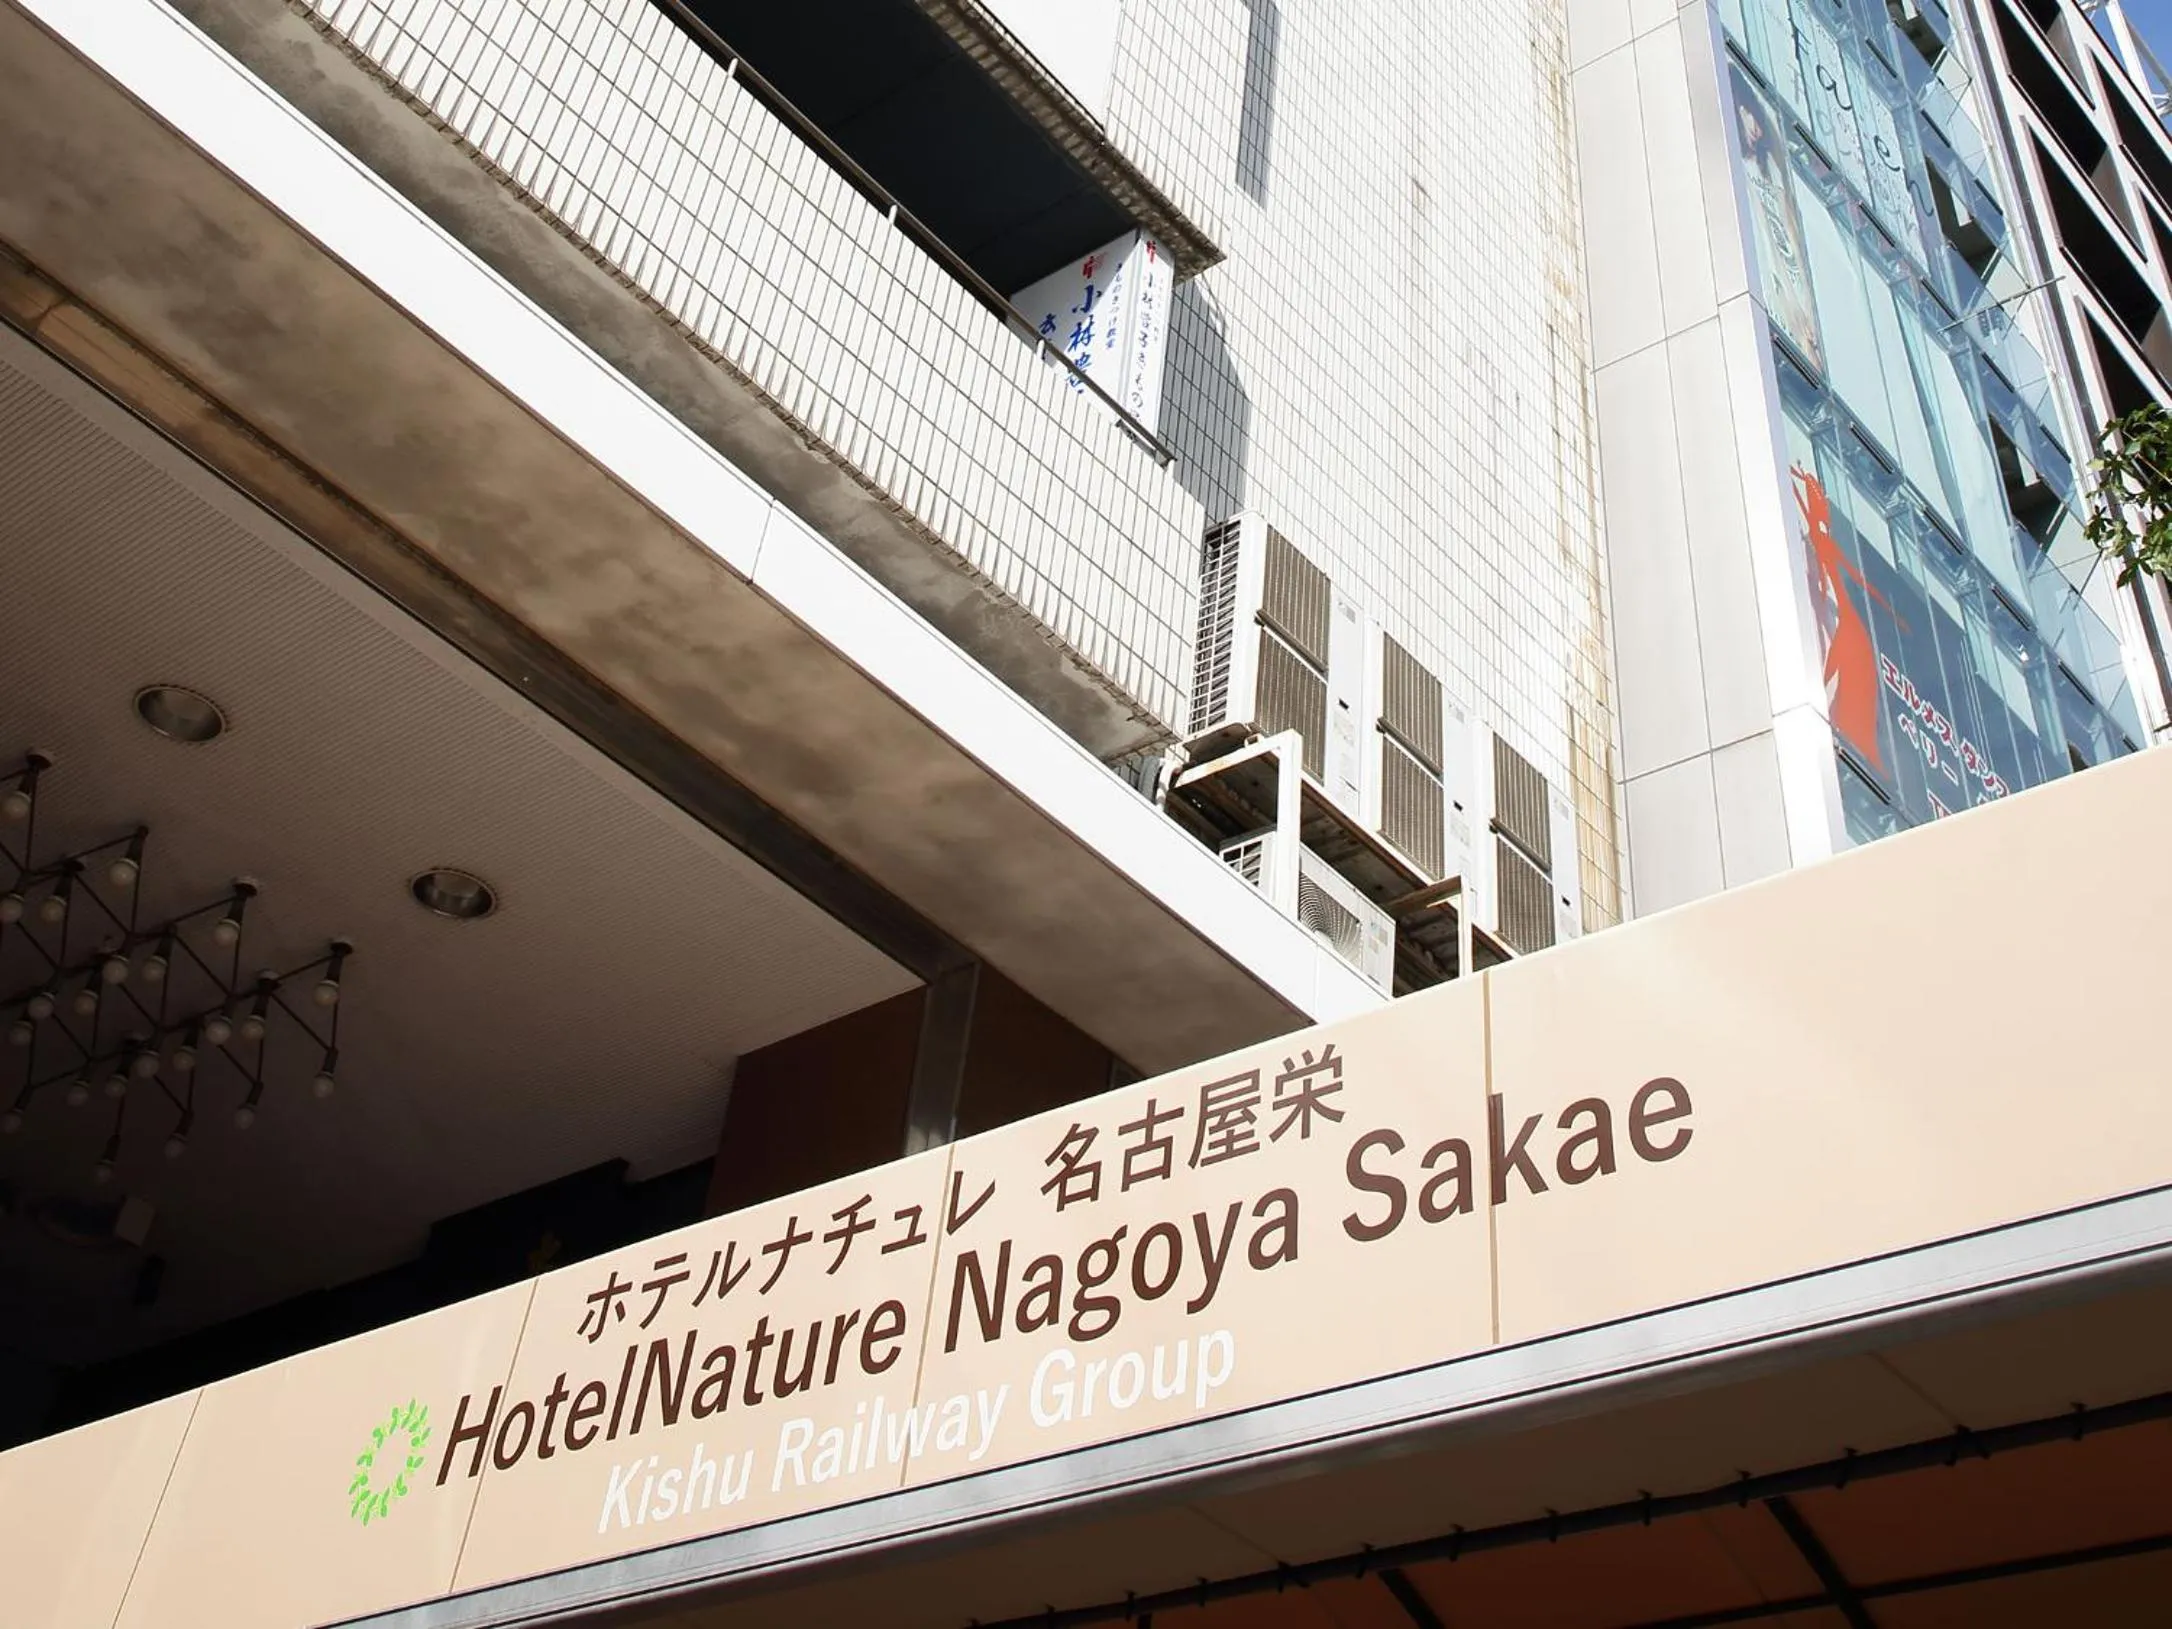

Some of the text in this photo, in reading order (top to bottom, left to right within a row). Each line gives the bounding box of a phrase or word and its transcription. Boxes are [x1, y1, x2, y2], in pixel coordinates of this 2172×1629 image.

[576, 1043, 1346, 1345] ホテルナチュレ 名古屋栄
[943, 1186, 1300, 1355] Nagoya
[1341, 1076, 1695, 1243] Sakae
[597, 1328, 1237, 1535] Kishu Railway Group
